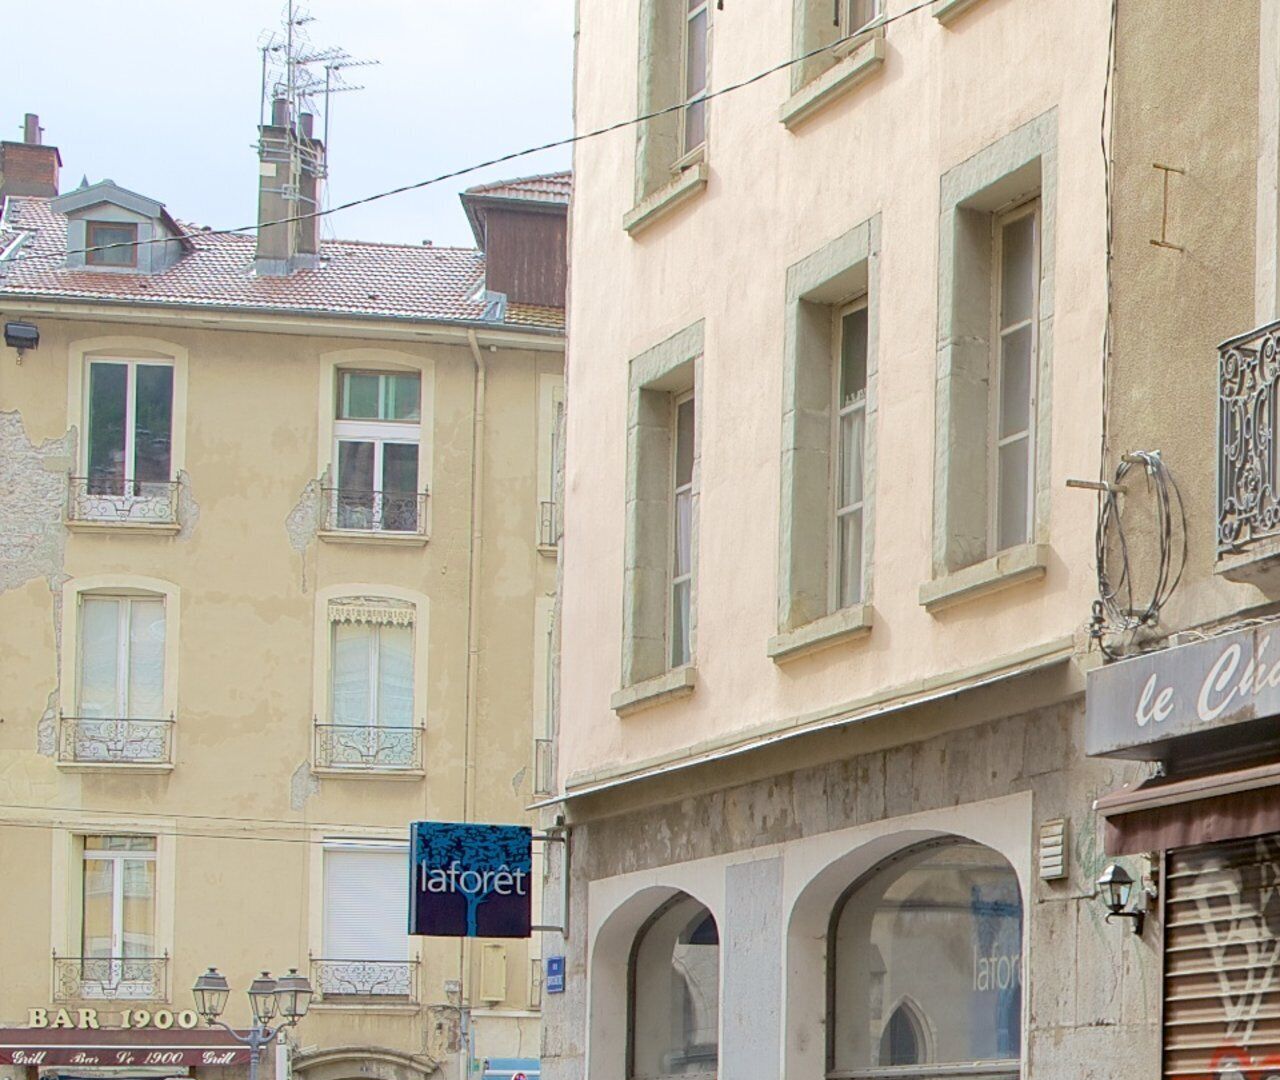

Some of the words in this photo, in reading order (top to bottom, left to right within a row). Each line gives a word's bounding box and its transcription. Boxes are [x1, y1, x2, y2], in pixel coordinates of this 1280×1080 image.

[1134, 671, 1175, 728] le
[420, 858, 527, 896] laforêt
[972, 942, 1023, 991] lafor
[27, 1007, 100, 1030] BAR
[120, 1008, 198, 1030] 1900
[11, 1050, 47, 1065] Grill
[69, 1051, 100, 1065] Bar
[143, 1051, 184, 1065] 1900
[201, 1050, 237, 1065] Grill
